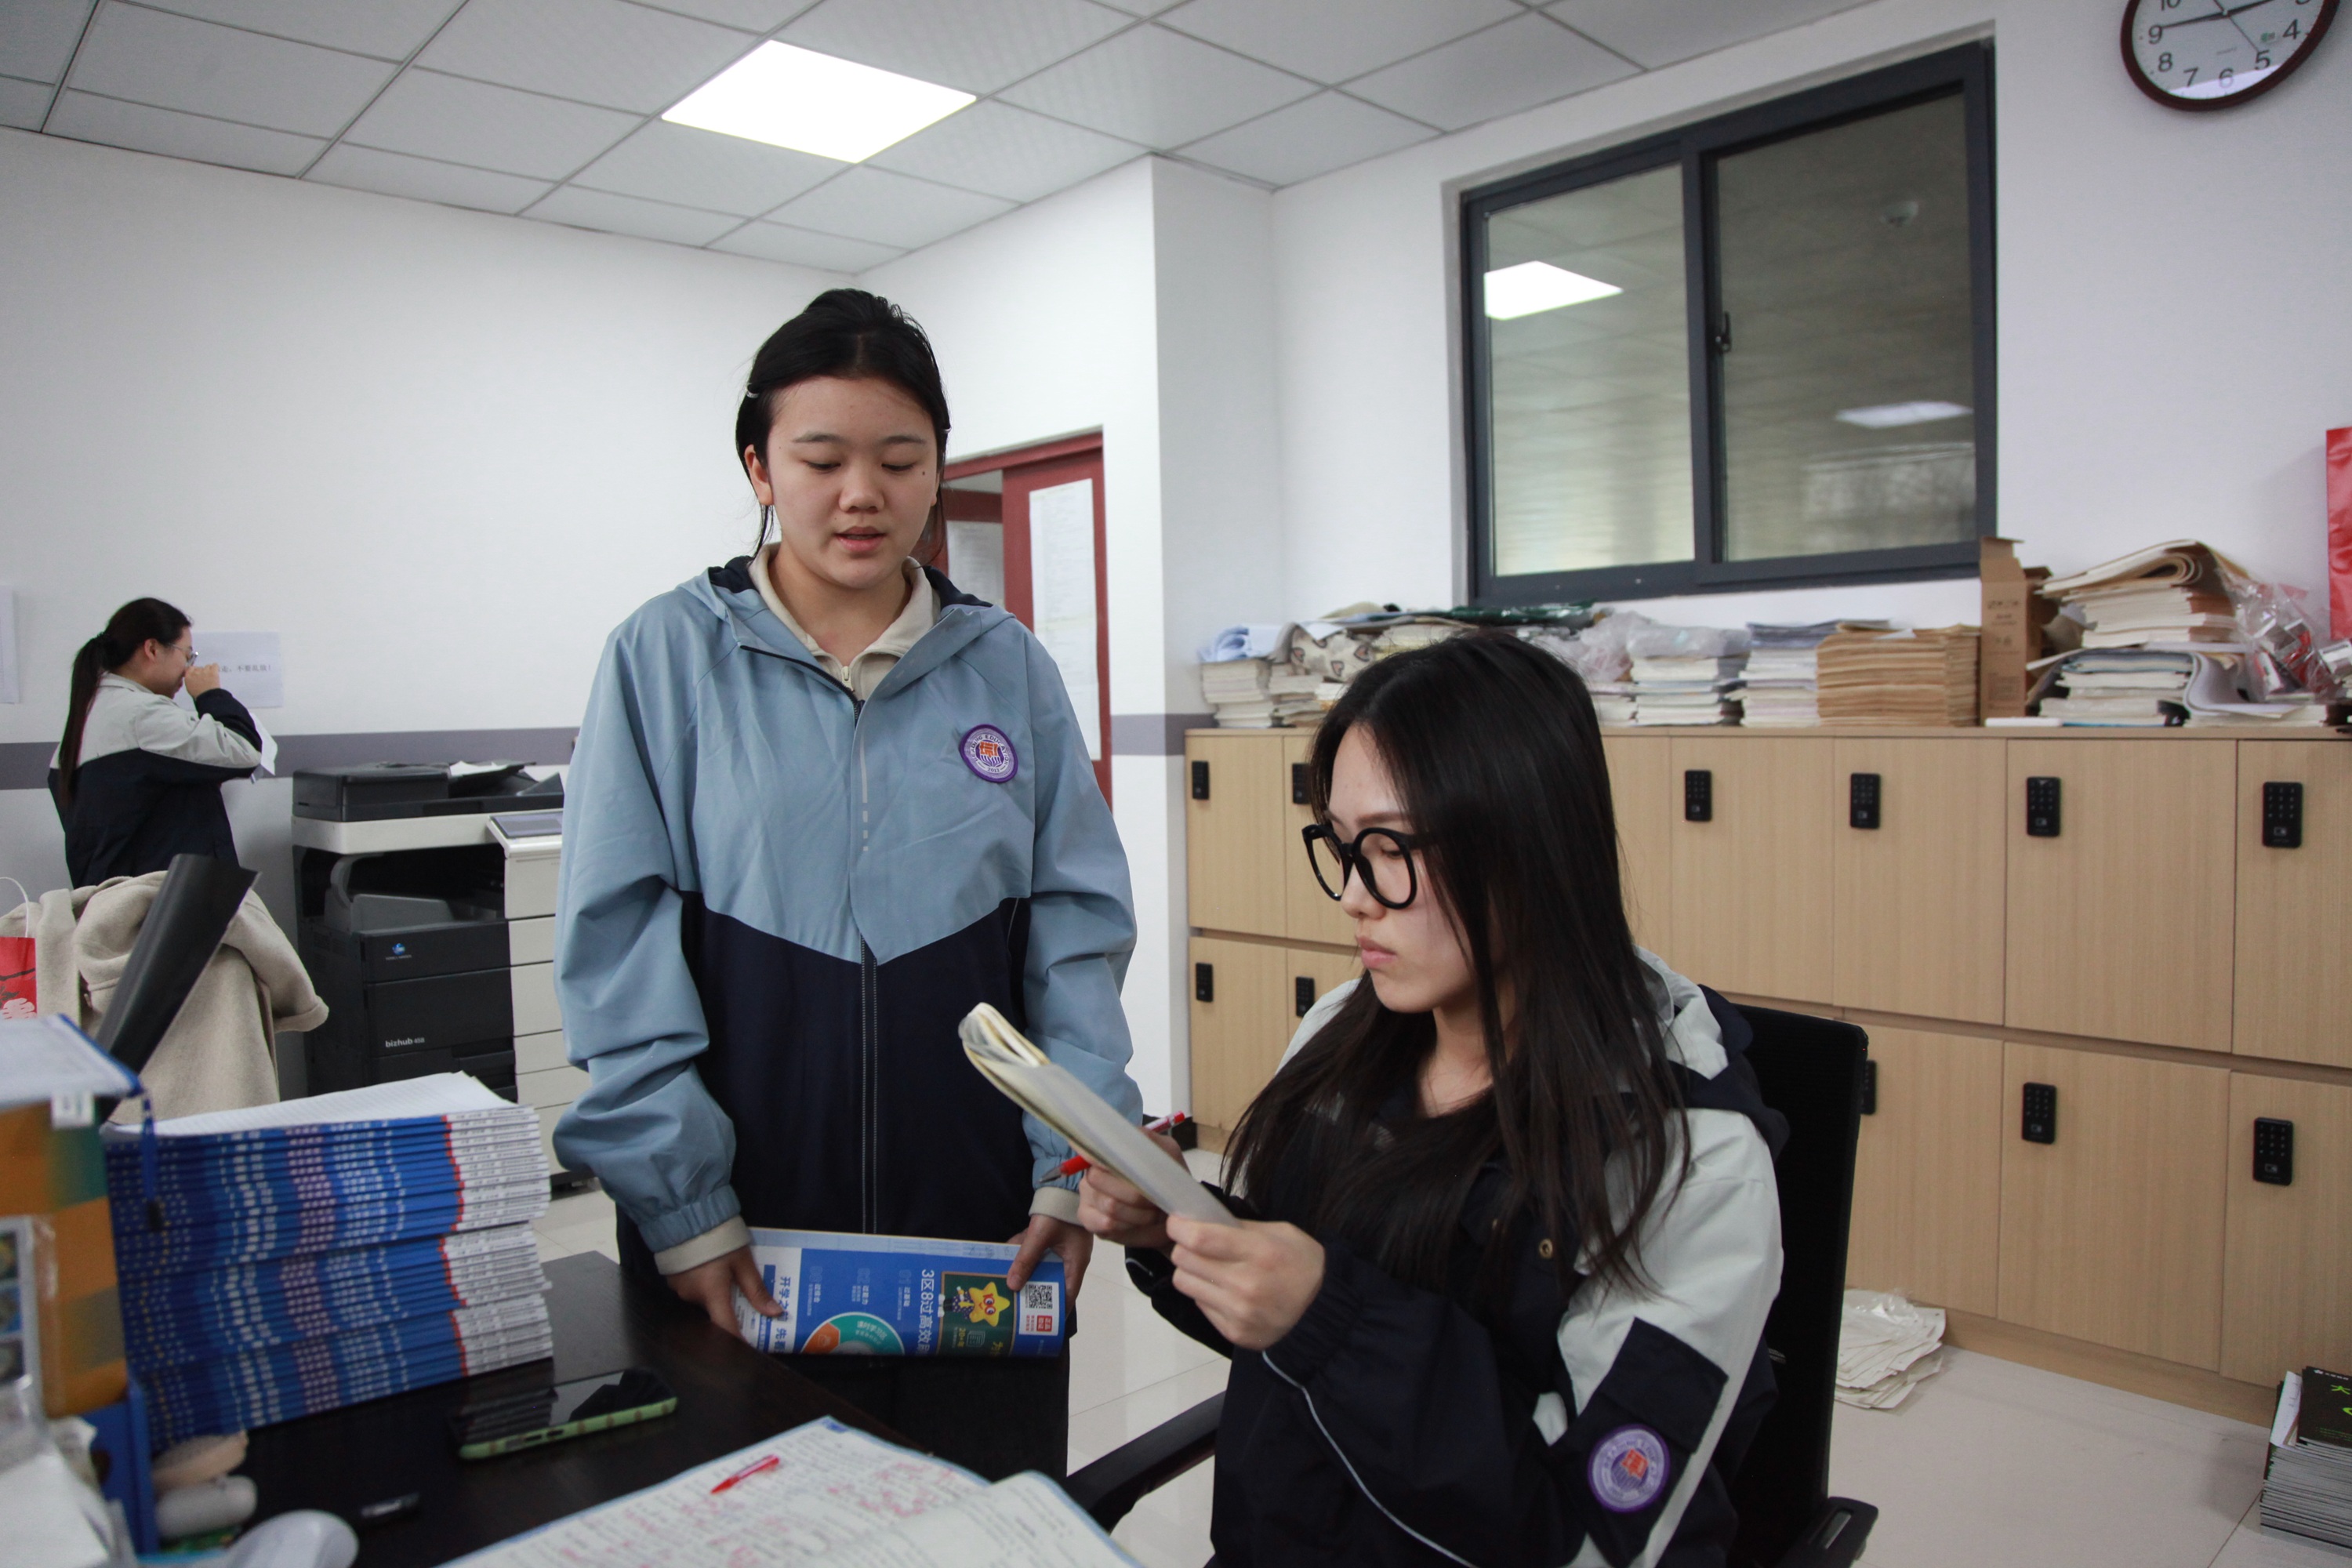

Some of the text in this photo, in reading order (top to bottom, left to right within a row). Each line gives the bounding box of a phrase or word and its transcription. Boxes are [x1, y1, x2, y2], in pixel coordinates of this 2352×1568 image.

[2148, 24, 2163, 45] 9
[2282, 19, 2301, 40] 4
[2158, 52, 2172, 72] 8
[2255, 49, 2270, 71] 5
[2183, 67, 2198, 87] 7
[2218, 68, 2234, 89] 6
[971, 734, 1010, 766] LEADING EDUCATION
[385, 1037, 413, 1047] bizhub
[774, 1327, 788, 1352] 先看
